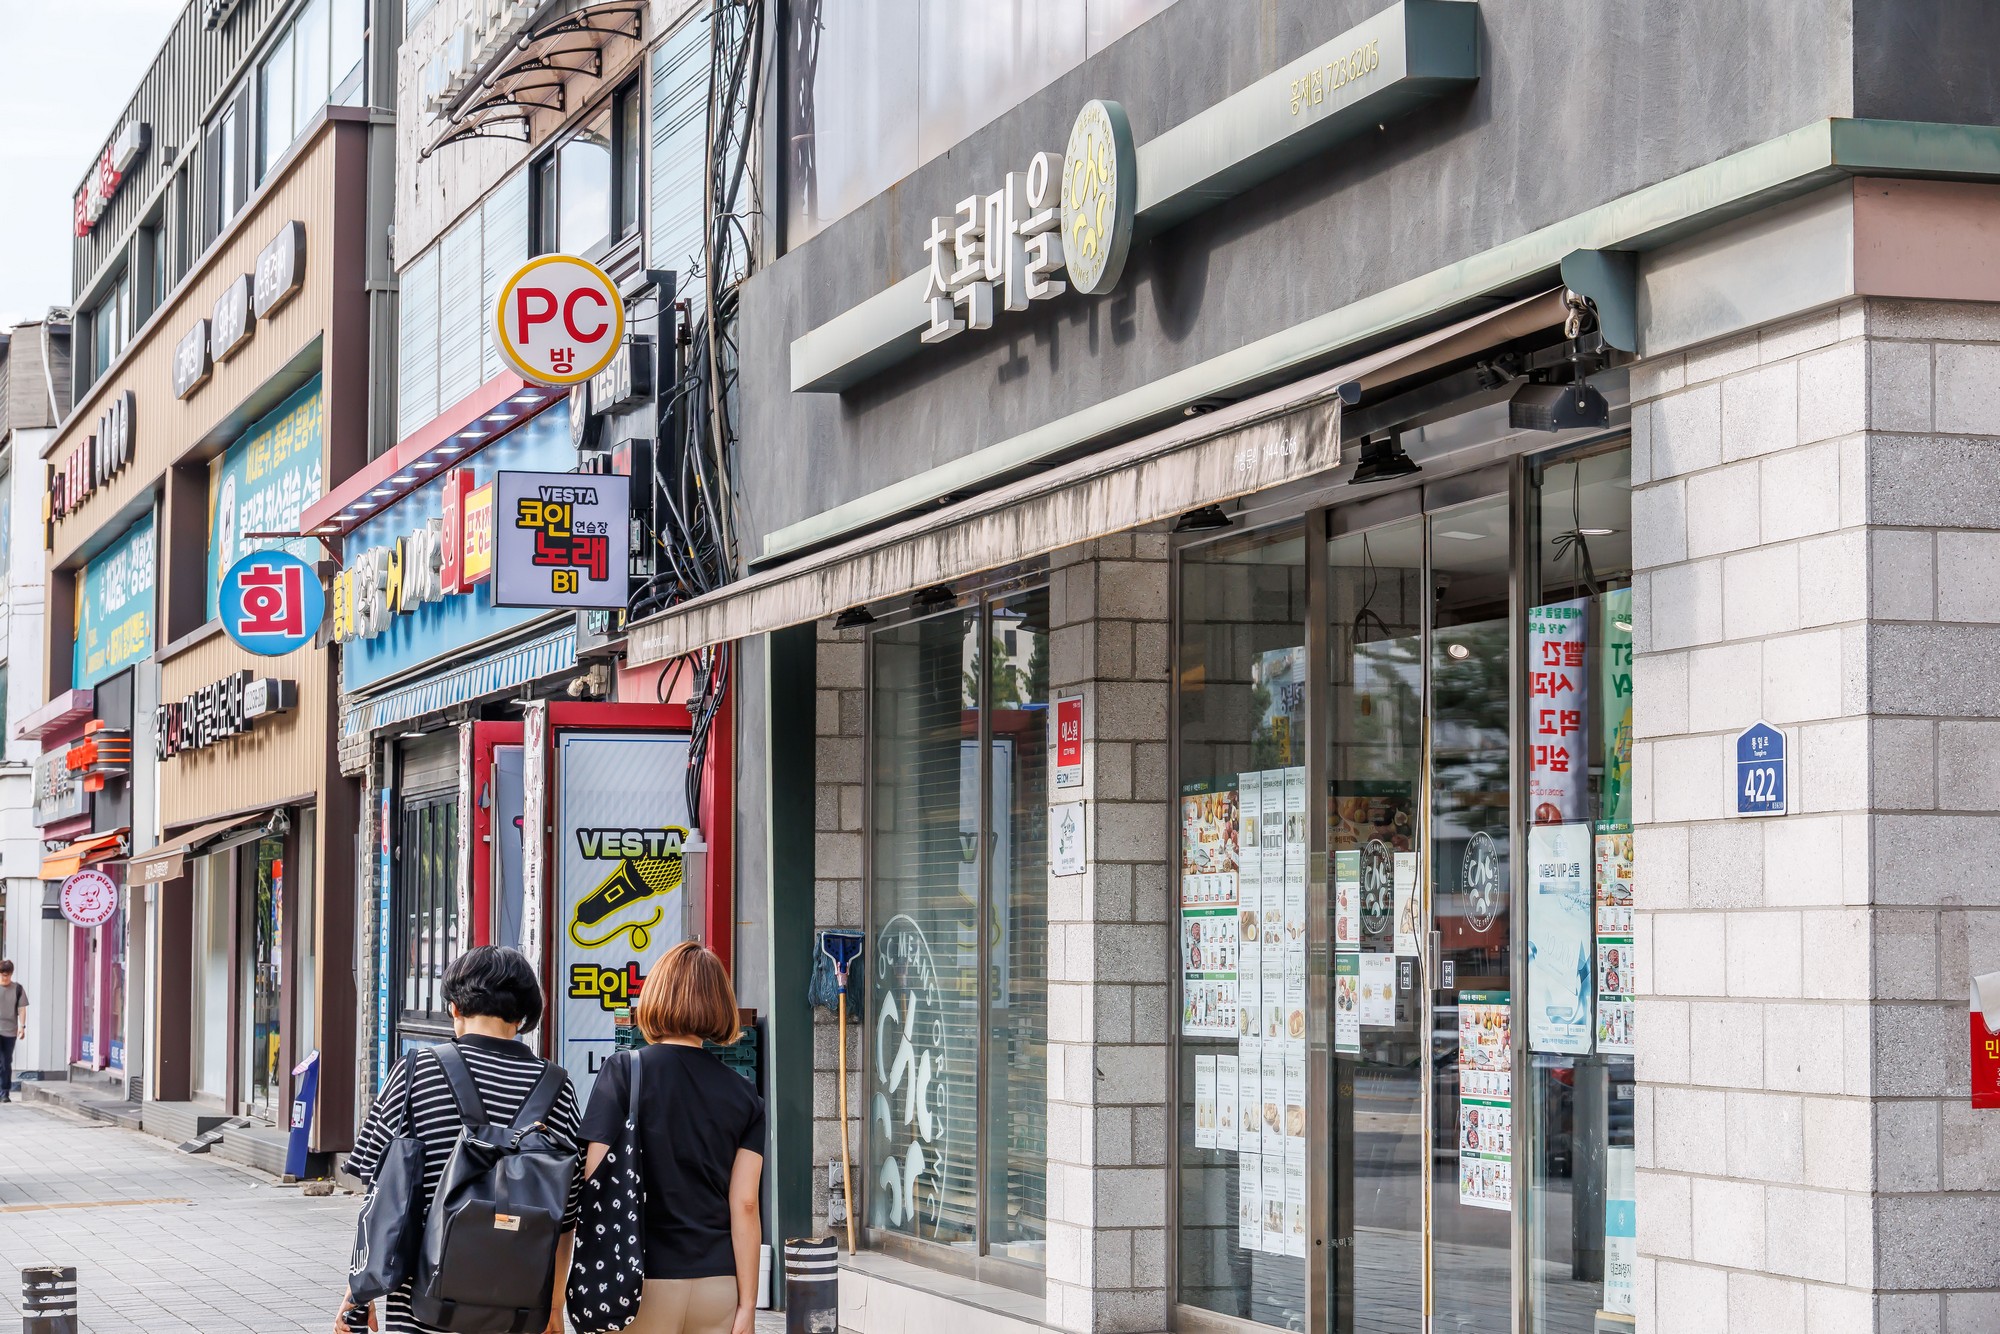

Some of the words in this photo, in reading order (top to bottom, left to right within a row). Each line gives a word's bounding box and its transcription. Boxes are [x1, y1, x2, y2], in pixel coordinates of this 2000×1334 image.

[1289, 79, 1323, 116] 홍제점
[1326, 38, 1380, 94] 723.6205
[921, 151, 1066, 344] 초록마을
[1072, 260, 1090, 284] SINCE
[516, 287, 609, 345] PC
[549, 347, 575, 374] 방
[539, 486, 598, 505] VESTA
[440, 467, 473, 594] 회
[516, 498, 574, 538] 코인
[575, 520, 609, 535] 연습장
[533, 534, 609, 582] 노래
[551, 570, 580, 594] B1
[238, 563, 306, 637] 회
[1061, 719, 1078, 741] 에스원
[1751, 736, 1769, 750] 통일로
[1744, 767, 1776, 803] 422
[578, 828, 684, 860] VESTA
[65, 884, 73, 896] no
[72, 873, 95, 884] more
[96, 875, 114, 895] pizza
[1538, 863, 1556, 878] 이달의
[1557, 862, 1567, 878] VIP
[1568, 862, 1580, 878] 선물
[65, 901, 73, 913] no
[72, 913, 95, 923] more
[97, 901, 114, 922] pizza
[897, 931, 935, 1007] MEANS
